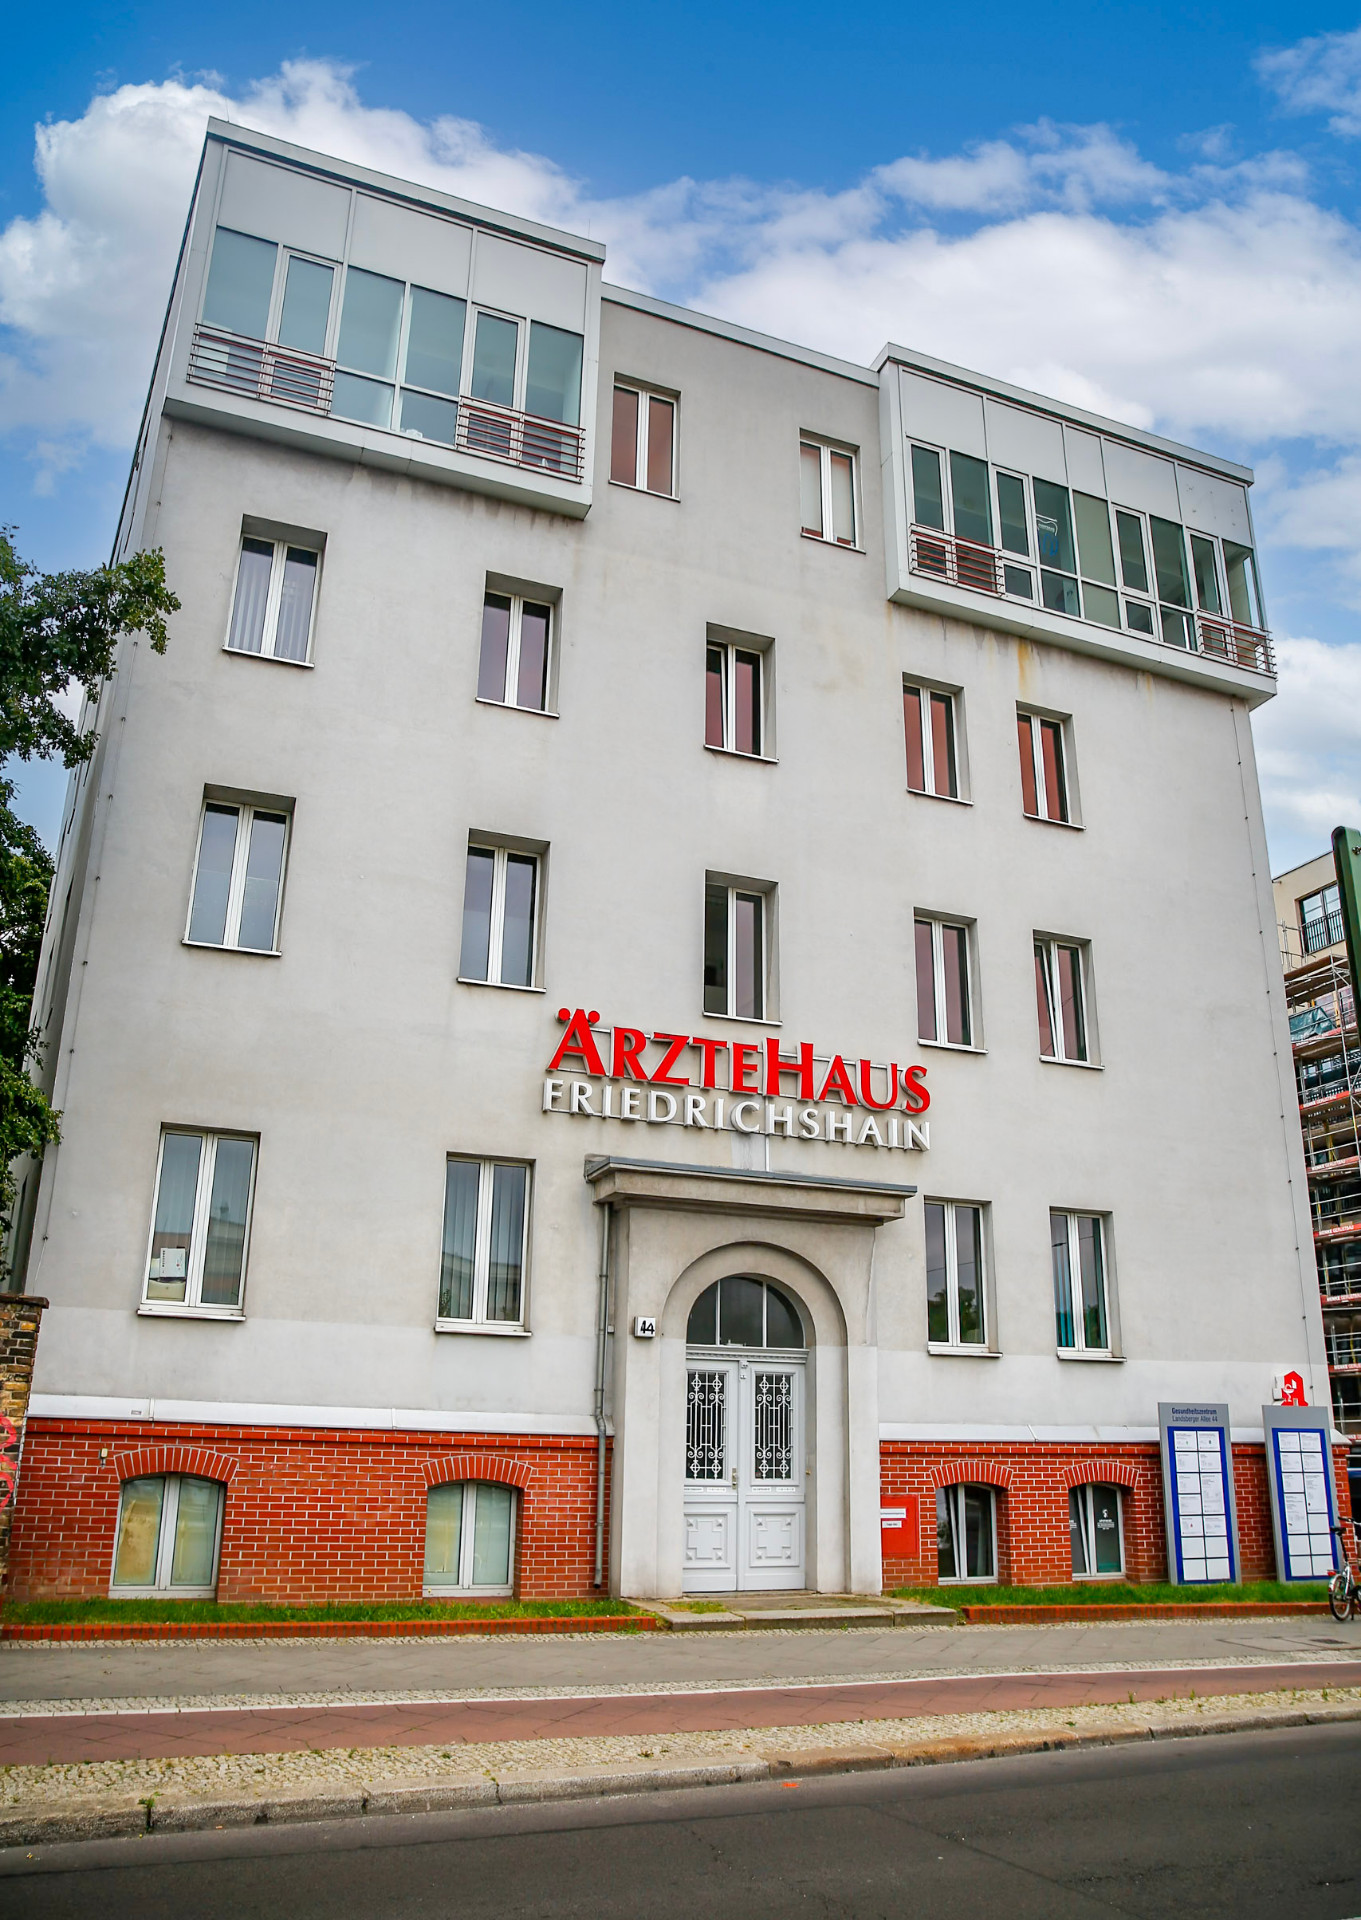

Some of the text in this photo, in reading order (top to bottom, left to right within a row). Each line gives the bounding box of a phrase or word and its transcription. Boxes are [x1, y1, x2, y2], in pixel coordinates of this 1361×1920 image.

[547, 1008, 931, 1115] ÄRZTEHAUS
[542, 1078, 931, 1152] FRIEDRICHSHAIN
[640, 1320, 655, 1334] 44
